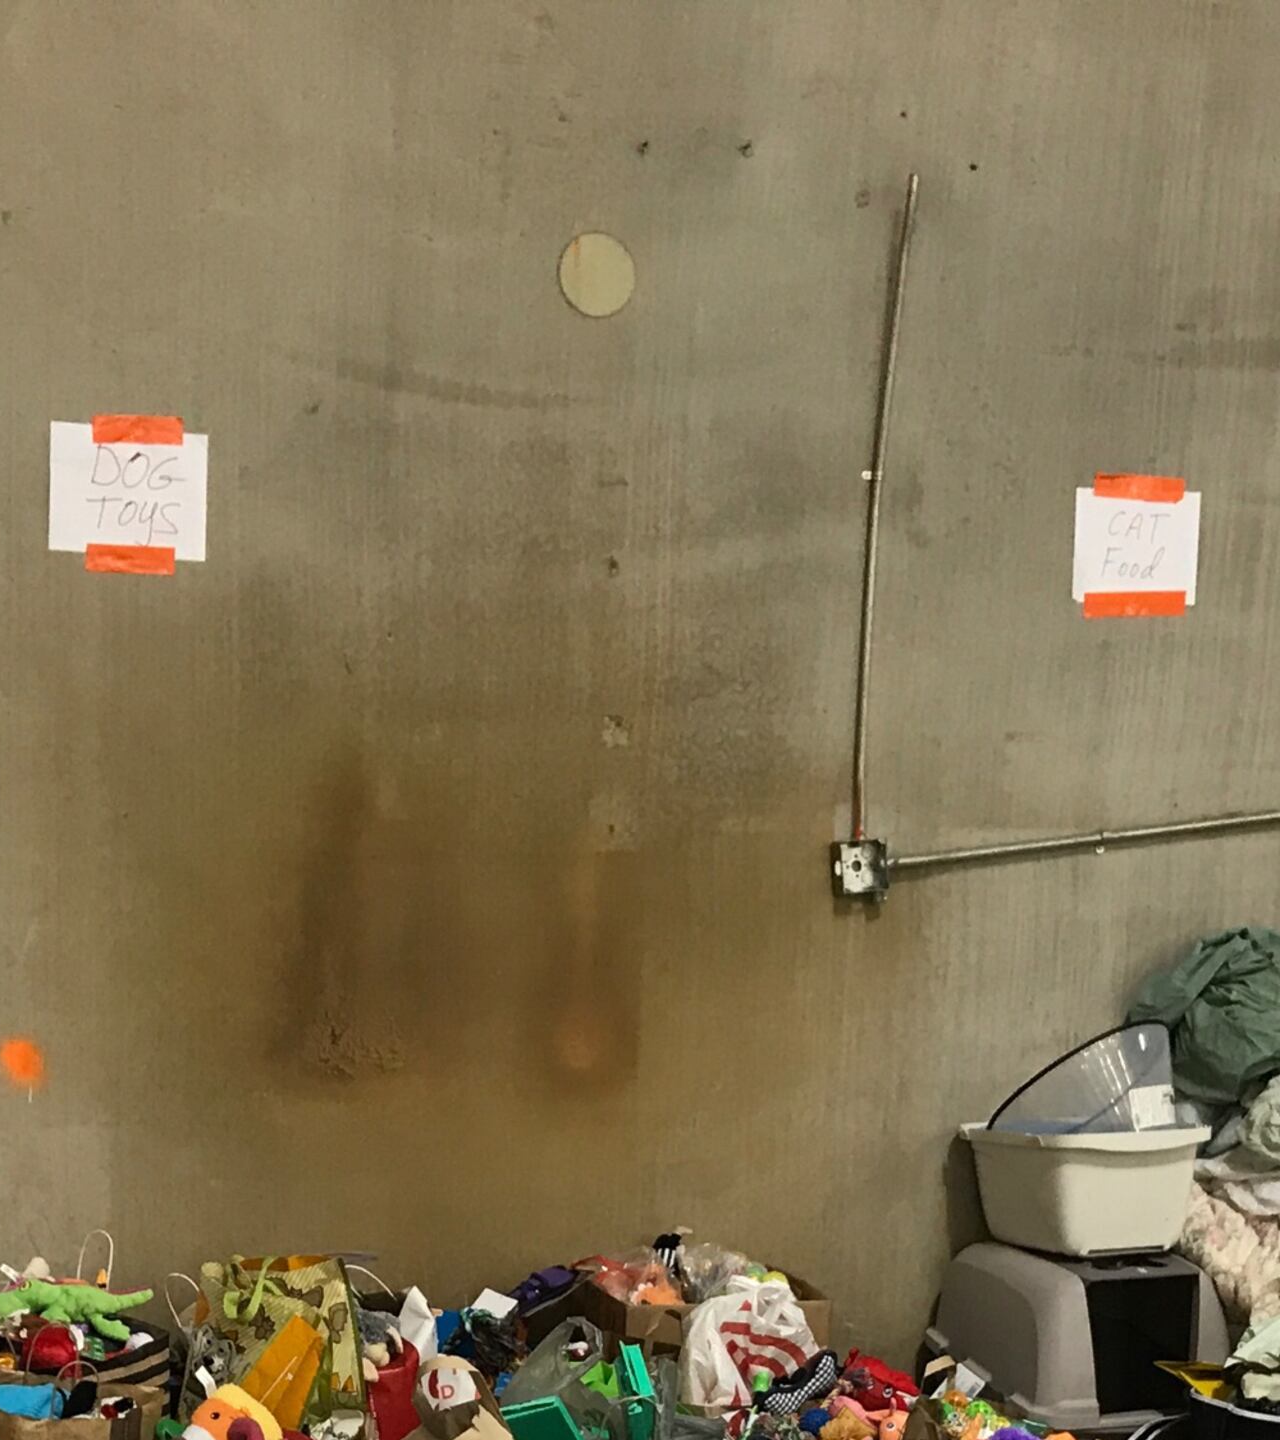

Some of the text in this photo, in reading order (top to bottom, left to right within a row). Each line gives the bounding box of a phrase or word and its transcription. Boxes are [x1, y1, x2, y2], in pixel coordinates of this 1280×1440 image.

[90, 444, 187, 490] DOG
[1107, 510, 1171, 544] CAT
[1100, 546, 1166, 579] Food
